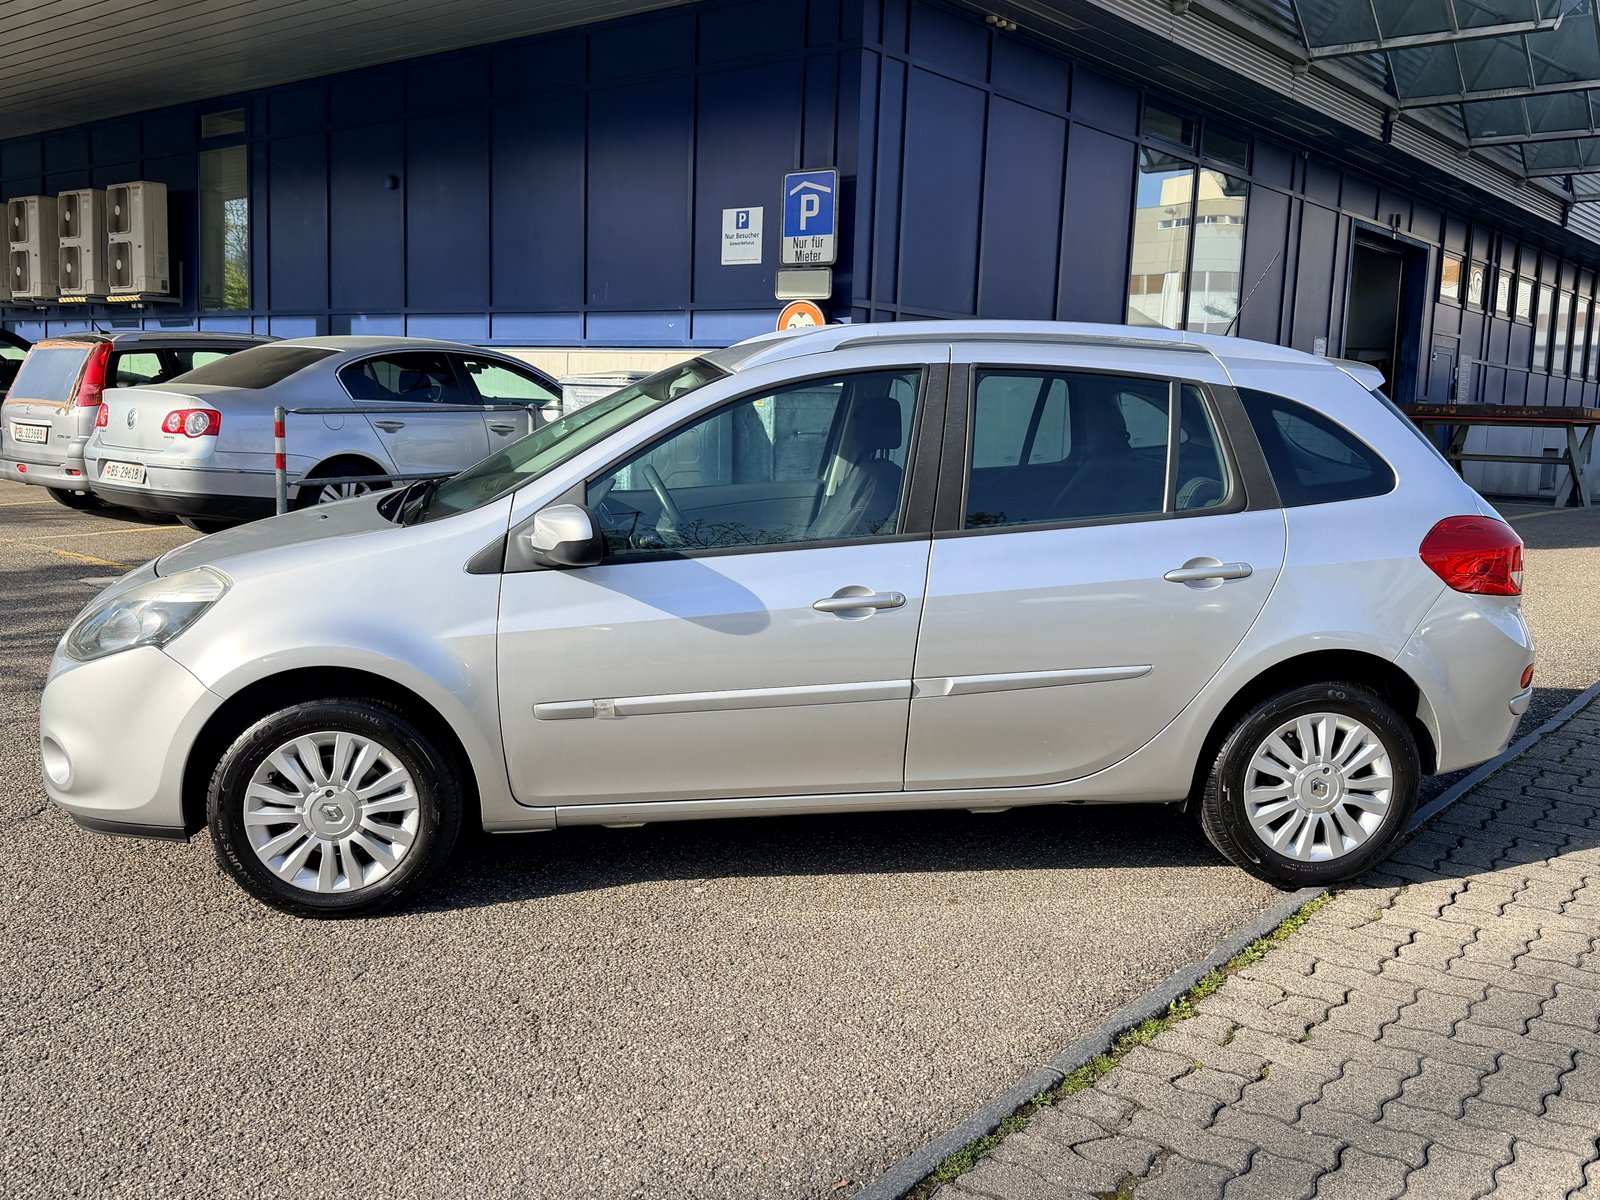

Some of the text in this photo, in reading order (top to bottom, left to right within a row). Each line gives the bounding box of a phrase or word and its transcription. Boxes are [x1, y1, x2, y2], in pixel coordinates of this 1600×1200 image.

[800, 193, 819, 230] P
[738, 212, 747, 228] P
[735, 231, 760, 239] Besucher
[792, 235, 824, 249] Nur für
[794, 249, 822, 262] Mieter
